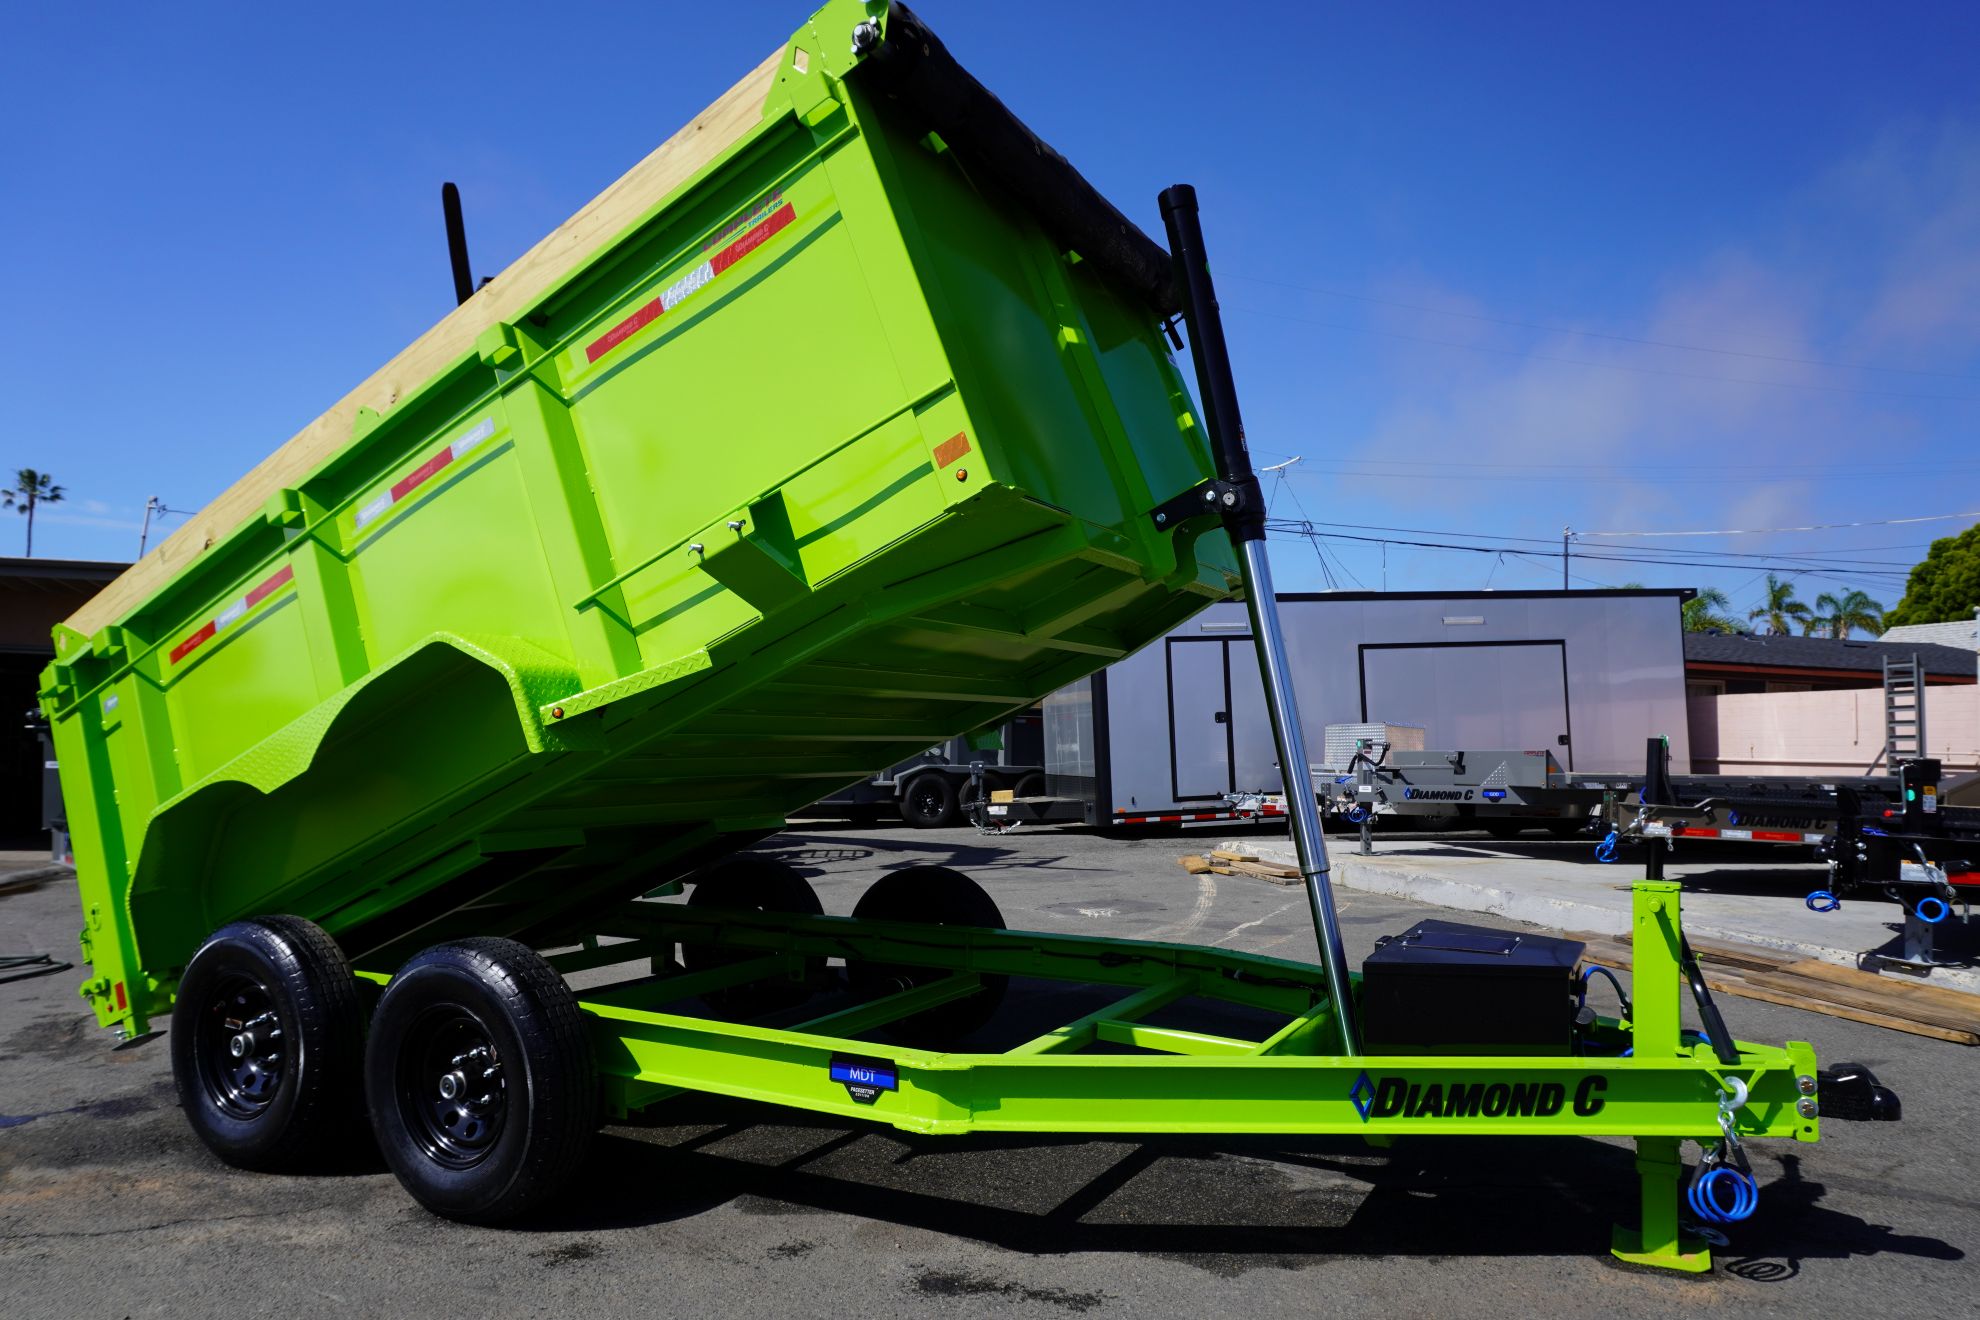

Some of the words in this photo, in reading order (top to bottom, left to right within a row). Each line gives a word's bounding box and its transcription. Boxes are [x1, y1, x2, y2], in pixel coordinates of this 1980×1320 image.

[747, 199, 783, 228] TRAILERS
[1410, 788, 1462, 800] DIAMOND
[1464, 790, 1473, 800] C
[1738, 815, 1811, 829] DIAMOND
[1814, 818, 1828, 830] C
[849, 1067, 876, 1082] MDT
[1370, 1077, 1566, 1118] DIAMOND
[1573, 1075, 1608, 1117] C
